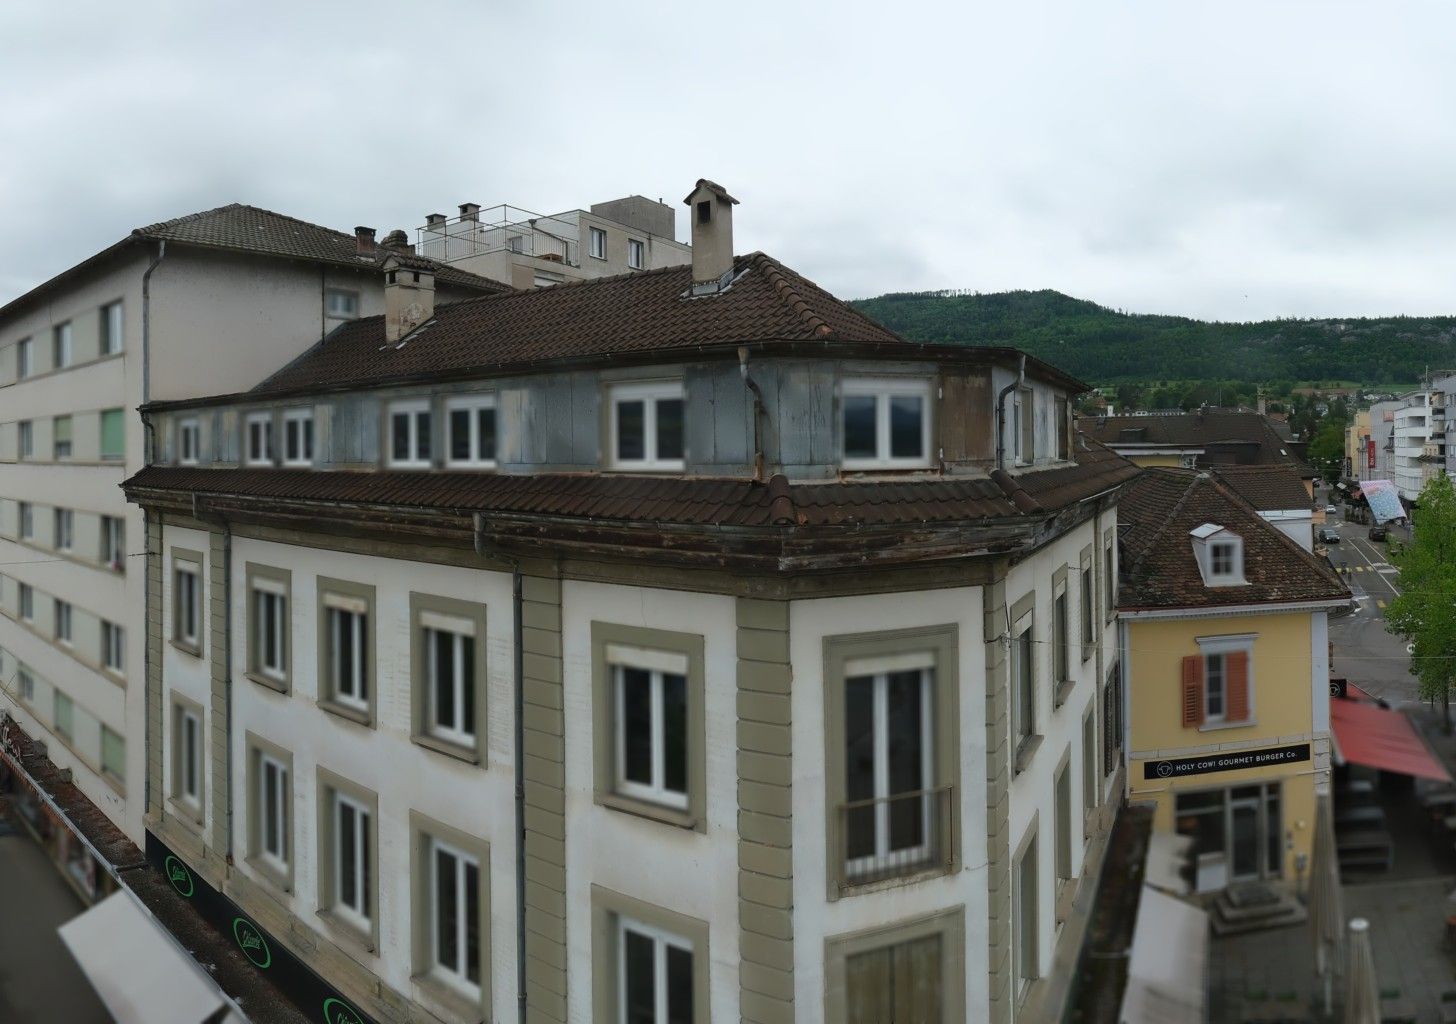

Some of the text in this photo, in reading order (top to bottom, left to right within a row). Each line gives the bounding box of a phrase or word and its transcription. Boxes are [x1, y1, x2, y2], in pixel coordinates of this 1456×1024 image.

[1176, 763, 1195, 771] HOLY
[1197, 761, 1216, 769] COW!
[1218, 756, 1254, 767] GOURMET
[1255, 752, 1284, 762] BURGER
